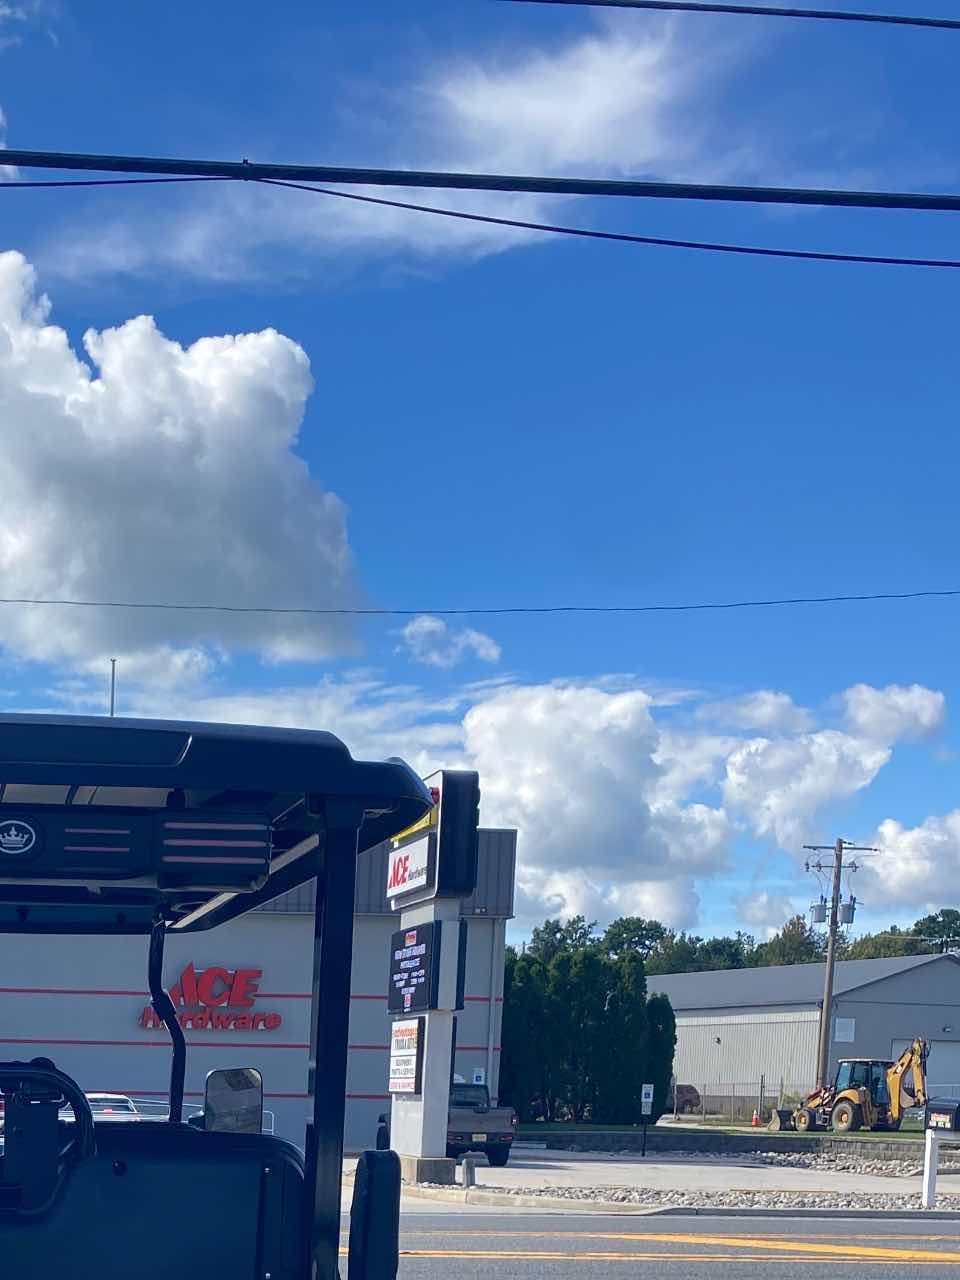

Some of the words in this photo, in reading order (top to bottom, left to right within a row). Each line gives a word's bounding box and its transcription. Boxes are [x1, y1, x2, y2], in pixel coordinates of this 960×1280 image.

[387, 854, 410, 889] ACE
[168, 961, 264, 1008] ACE
[141, 1007, 282, 1031] Hrdware
